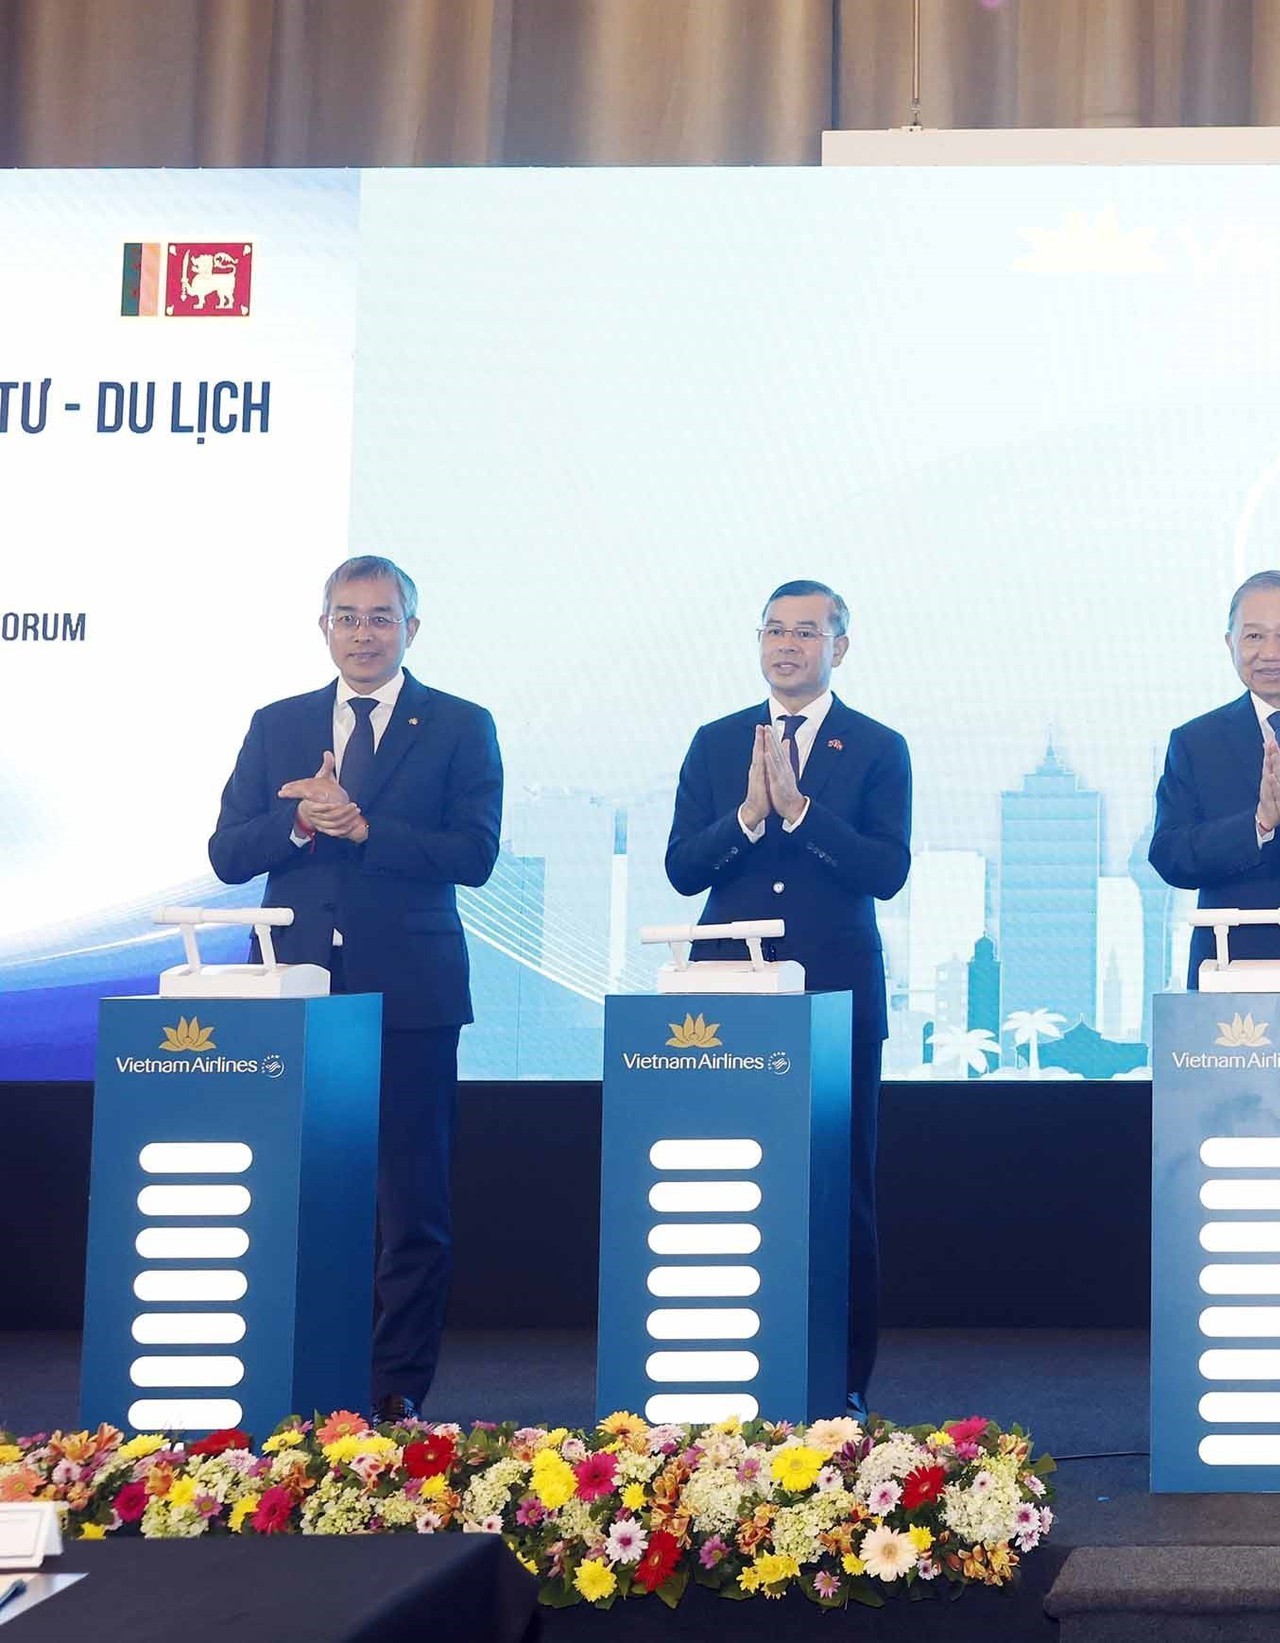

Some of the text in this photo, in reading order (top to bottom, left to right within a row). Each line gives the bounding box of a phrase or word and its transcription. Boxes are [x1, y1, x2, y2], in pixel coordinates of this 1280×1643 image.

[0, 378, 271, 445] TƯ - DU LỊCH
[2, 612, 86, 641] ORUM
[116, 1057, 190, 1073] Vietnam
[191, 1056, 258, 1073] Airlines
[623, 1053, 696, 1070] Vietnam
[698, 1052, 764, 1070] Airlines
[1172, 1052, 1246, 1069] Vietnam
